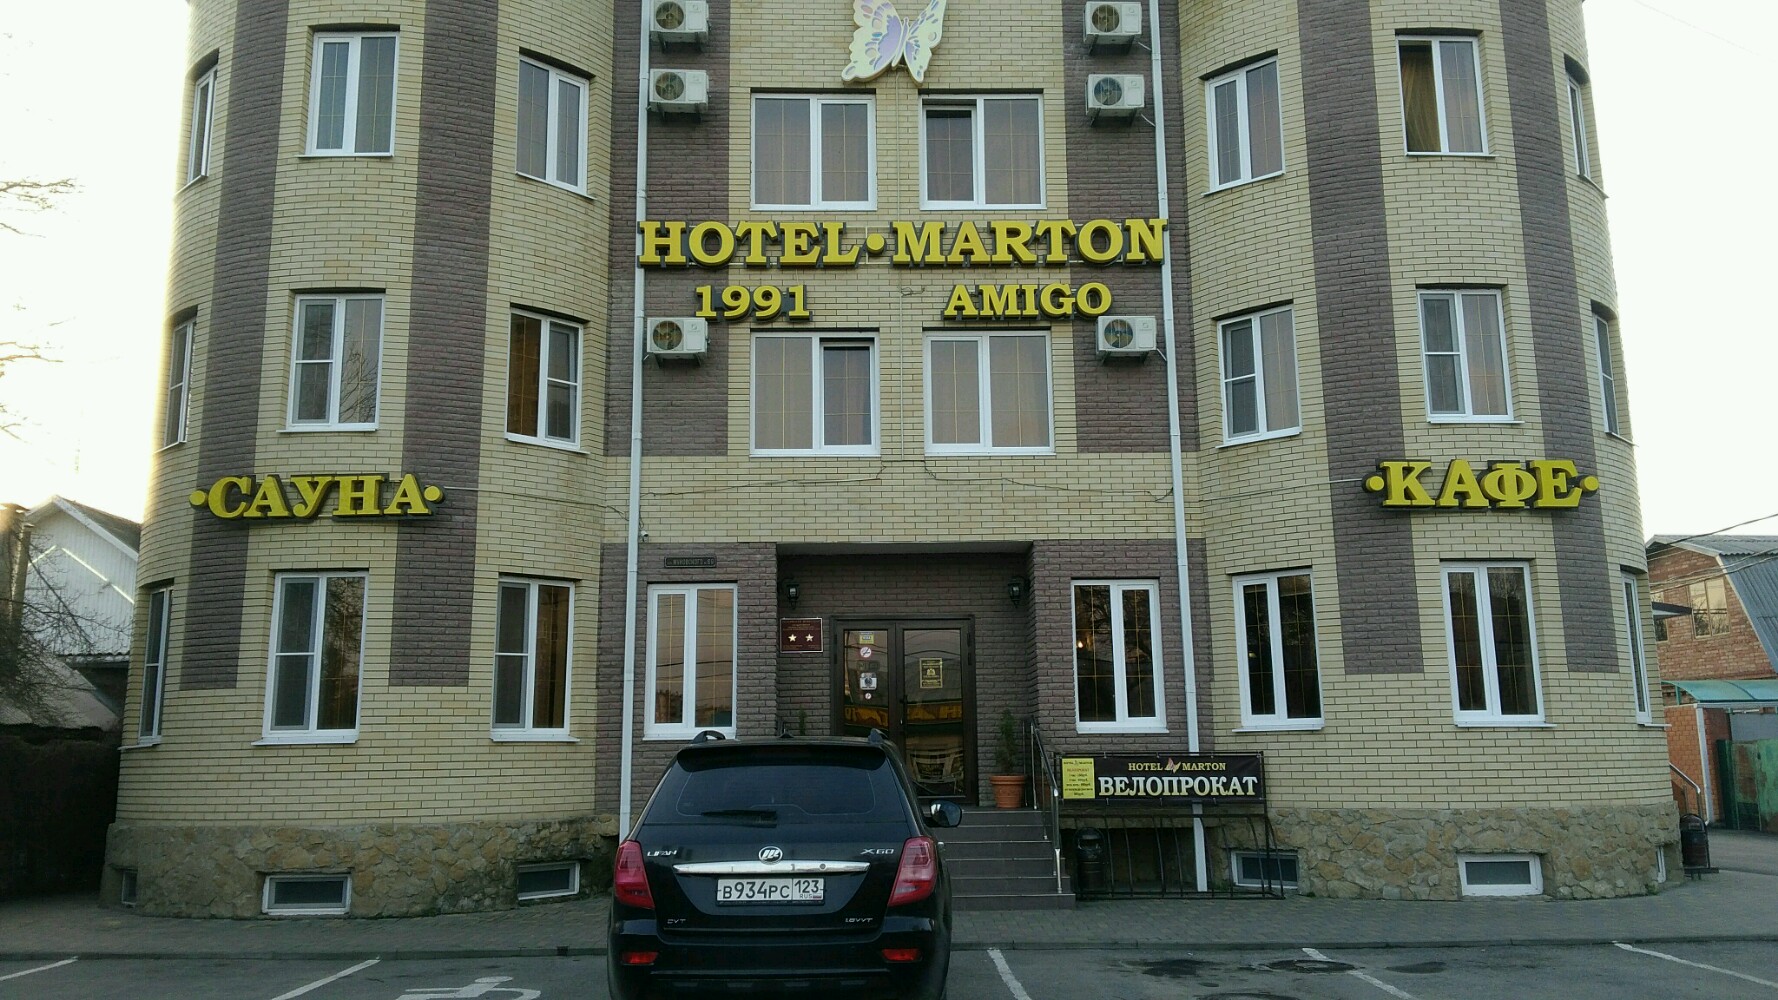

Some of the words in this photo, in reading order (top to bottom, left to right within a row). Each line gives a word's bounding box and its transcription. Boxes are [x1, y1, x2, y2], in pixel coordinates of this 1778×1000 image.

[638, 221, 861, 267] HOTEL
[891, 218, 1168, 266] MARTON
[696, 284, 812, 320] 1991
[943, 283, 1114, 319] AMIGO
[207, 473, 434, 519] САУНА
[1379, 459, 1584, 508] КАФЕ
[1128, 762, 1163, 771] HOTEL
[1181, 762, 1226, 771] MARTON
[1098, 776, 1258, 796] ВЕЛОПРОКАТ
[794, 879, 819, 894] 123
